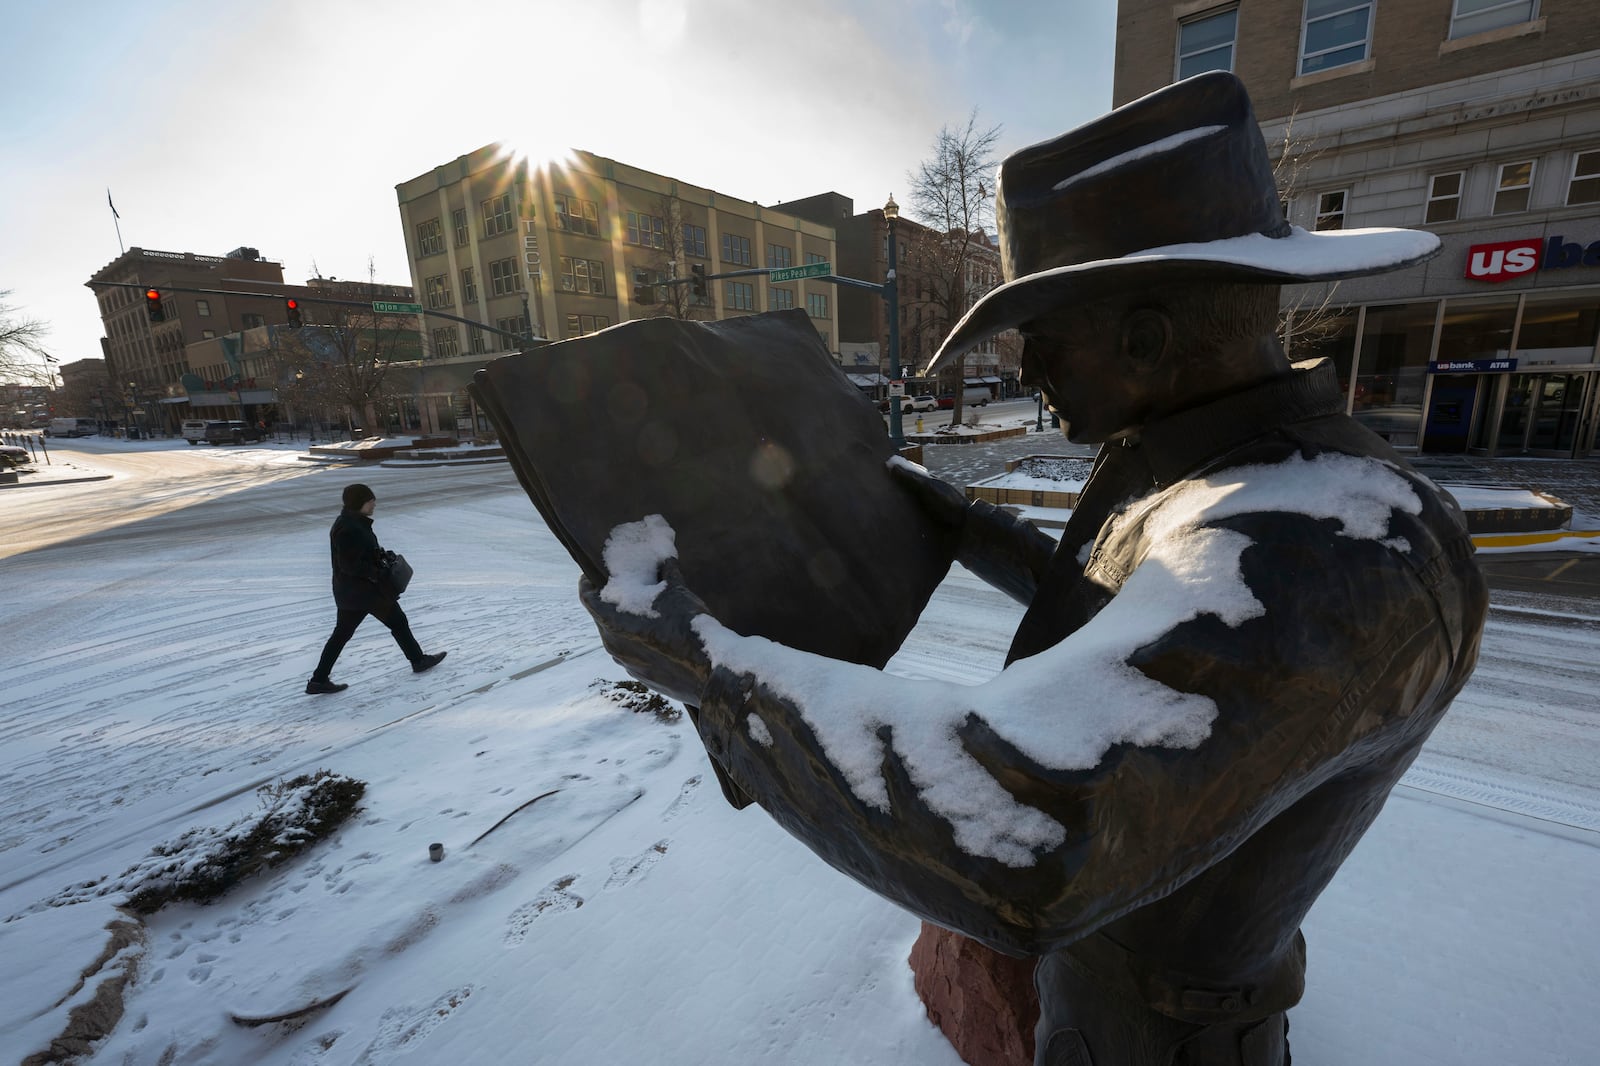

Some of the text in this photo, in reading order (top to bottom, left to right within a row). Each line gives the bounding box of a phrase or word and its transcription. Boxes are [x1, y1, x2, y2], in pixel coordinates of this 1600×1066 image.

[522, 220, 541, 279] TECH
[771, 271, 790, 281] Pikes
[791, 268, 807, 279] Peak
[375, 302, 397, 311] Tejon
[1489, 361, 1510, 369] ATM
